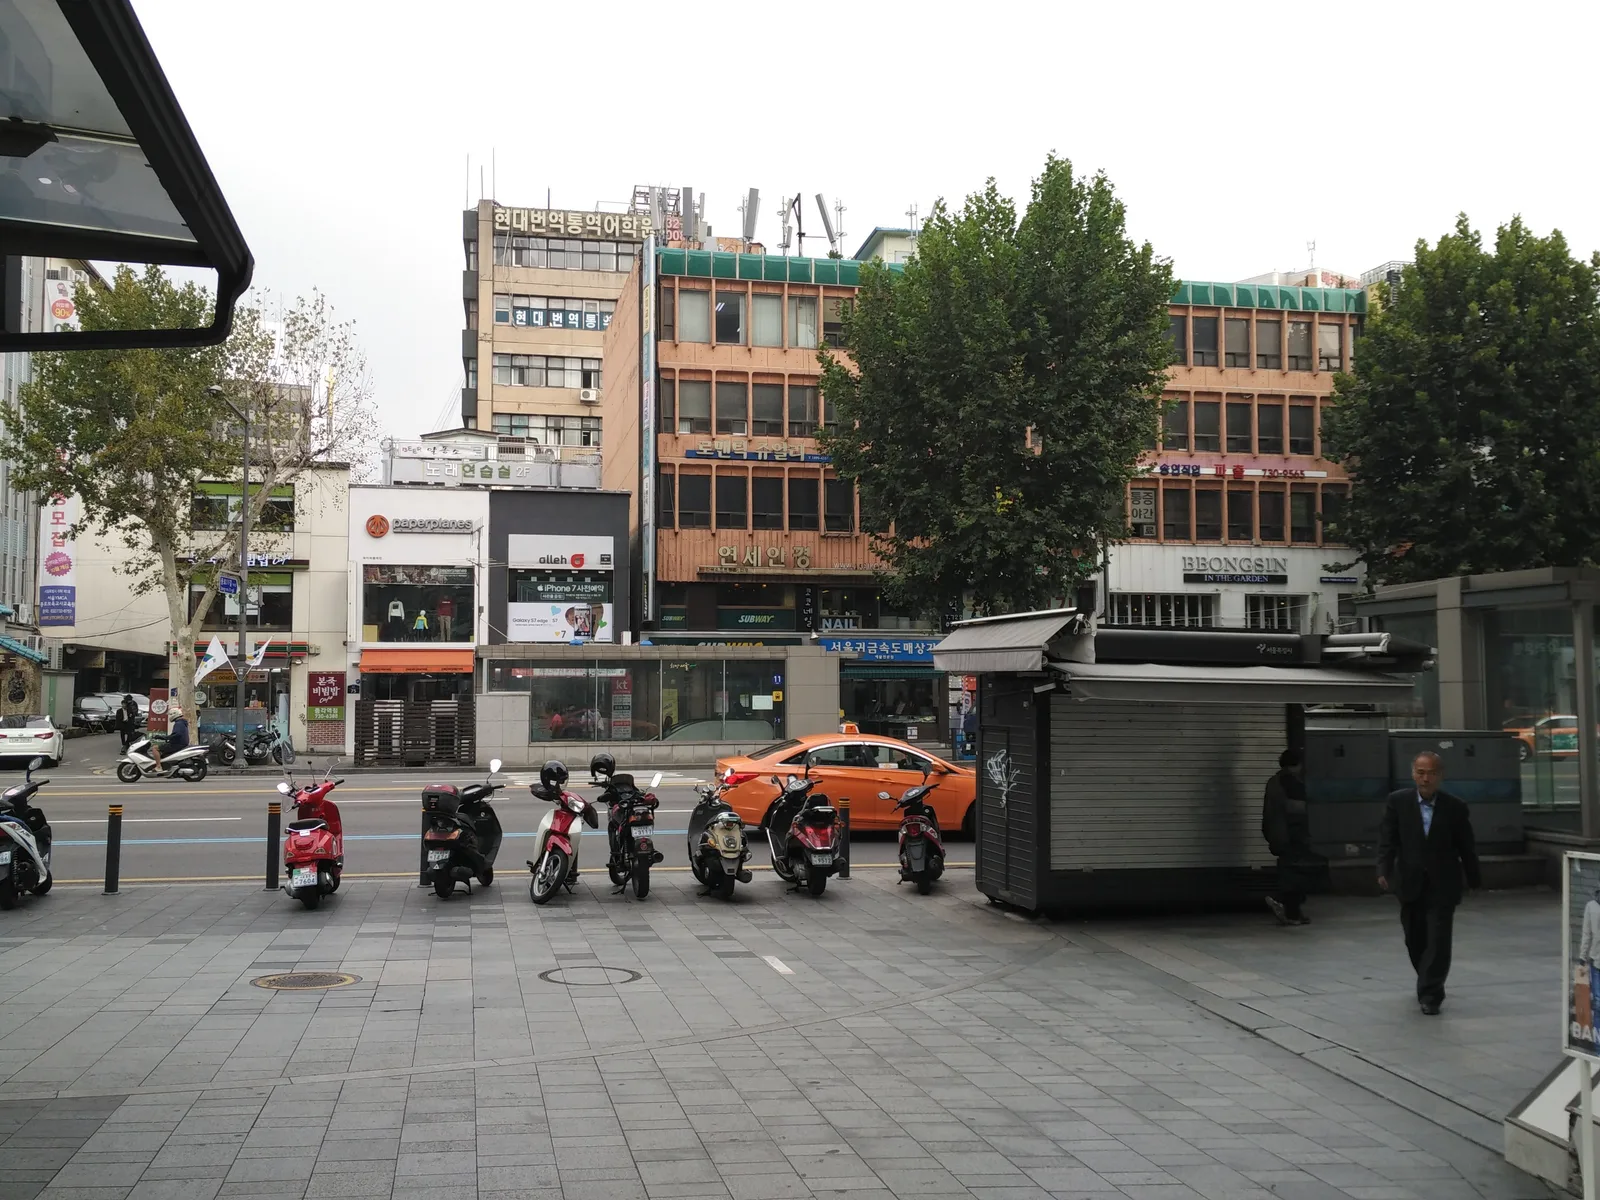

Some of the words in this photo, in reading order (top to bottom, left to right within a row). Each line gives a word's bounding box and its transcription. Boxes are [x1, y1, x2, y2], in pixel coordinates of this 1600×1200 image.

[696, 439, 748, 459] 로맨틱
[426, 463, 511, 479] 노래연습실
[516, 467, 530, 477] 2F
[1262, 468, 1305, 479] 730-9565
[393, 517, 472, 531] paperplanes
[718, 545, 811, 568] 연세안경
[1182, 556, 1288, 573] BBONGSIN
[1204, 574, 1214, 582] IN
[1216, 574, 1232, 582] THE
[1234, 574, 1269, 583] GARDEN
[738, 615, 775, 623] SUBWAY
[822, 618, 858, 629] NAIL
[316, 677, 337, 686] 본죽
[773, 675, 781, 683] 11
[616, 680, 628, 690] kt
[312, 686, 341, 697] 비빔밥
